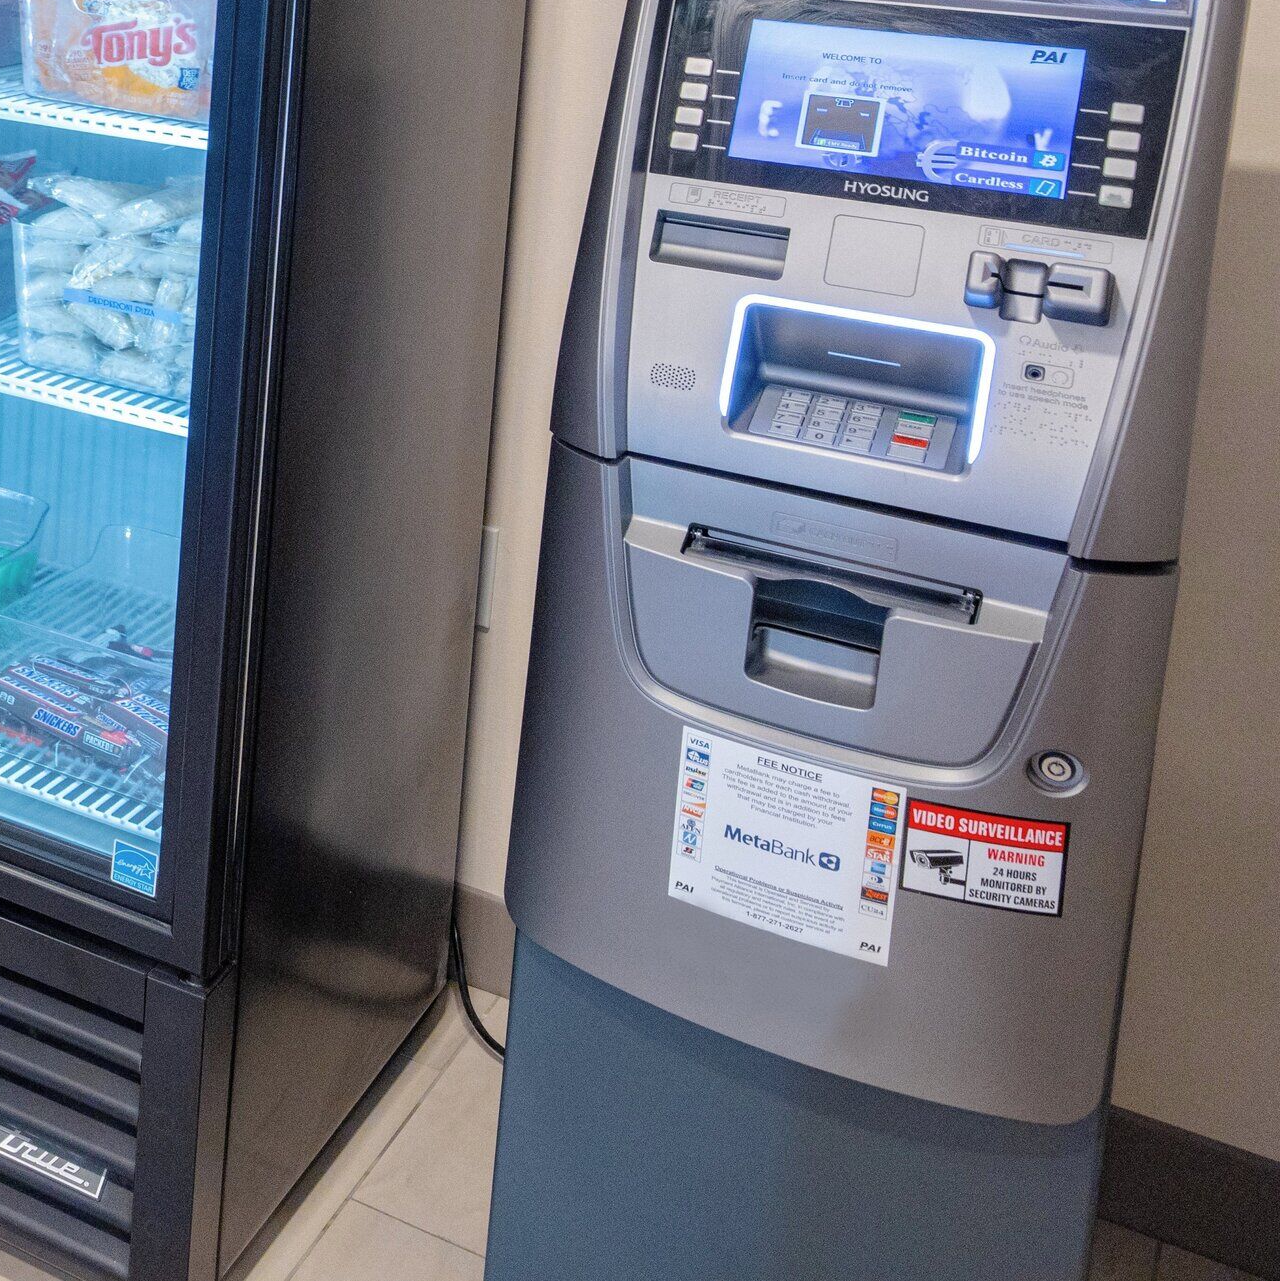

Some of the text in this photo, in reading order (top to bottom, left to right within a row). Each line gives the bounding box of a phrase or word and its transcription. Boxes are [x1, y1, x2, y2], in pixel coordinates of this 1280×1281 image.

[80, 16, 198, 67] Tony's
[822, 52, 882, 65] WELCOME TO
[1030, 49, 1069, 65] PAI
[782, 72, 806, 81] Insert
[809, 75, 828, 83] card
[830, 78, 847, 86] and
[849, 80, 861, 88] do
[863, 81, 877, 89] not
[960, 146, 1028, 164] Bitcoin
[955, 173, 1024, 190] Cardless
[713, 190, 762, 204] RECEIPT
[843, 180, 930, 203] HYOSUNG
[1022, 233, 1060, 248] CARD
[1032, 338, 1069, 352] Audio
[1003, 382, 1087, 402] Insert headphones
[1009, 391, 1026, 399] use
[1027, 394, 1061, 406] speech
[1063, 399, 1089, 410] mode
[34, 708, 81, 738] SNICKERS
[689, 738, 710, 750] VISA
[757, 756, 823, 783] FEE NOTICE
[724, 767, 764, 785] cardholders
[775, 783, 793, 793] each
[794, 787, 811, 798] cash
[812, 793, 850, 808] withdrawal.
[737, 764, 770, 779] MetaBank
[771, 774, 787, 783] may
[788, 779, 813, 791] charge
[820, 788, 831, 796] fee
[912, 807, 1063, 847] VIDEO SURVEILLANCE
[724, 823, 817, 867] MetaBank
[867, 849, 891, 864] STAR
[987, 848, 1045, 867] WARNING
[113, 872, 153, 893] ENERGY STAR
[992, 866, 1037, 881] 24 HOURS
[675, 880, 695, 894] PAI
[749, 875, 777, 890] Problems
[786, 888, 820, 904] Suspicious
[820, 898, 844, 911] Activity
[980, 878, 1047, 895] MONITORED BY
[969, 888, 1056, 910] SECURITY CAMERAS
[746, 910, 804, 934] 1-877-271-2627
[860, 941, 882, 954] PAI
